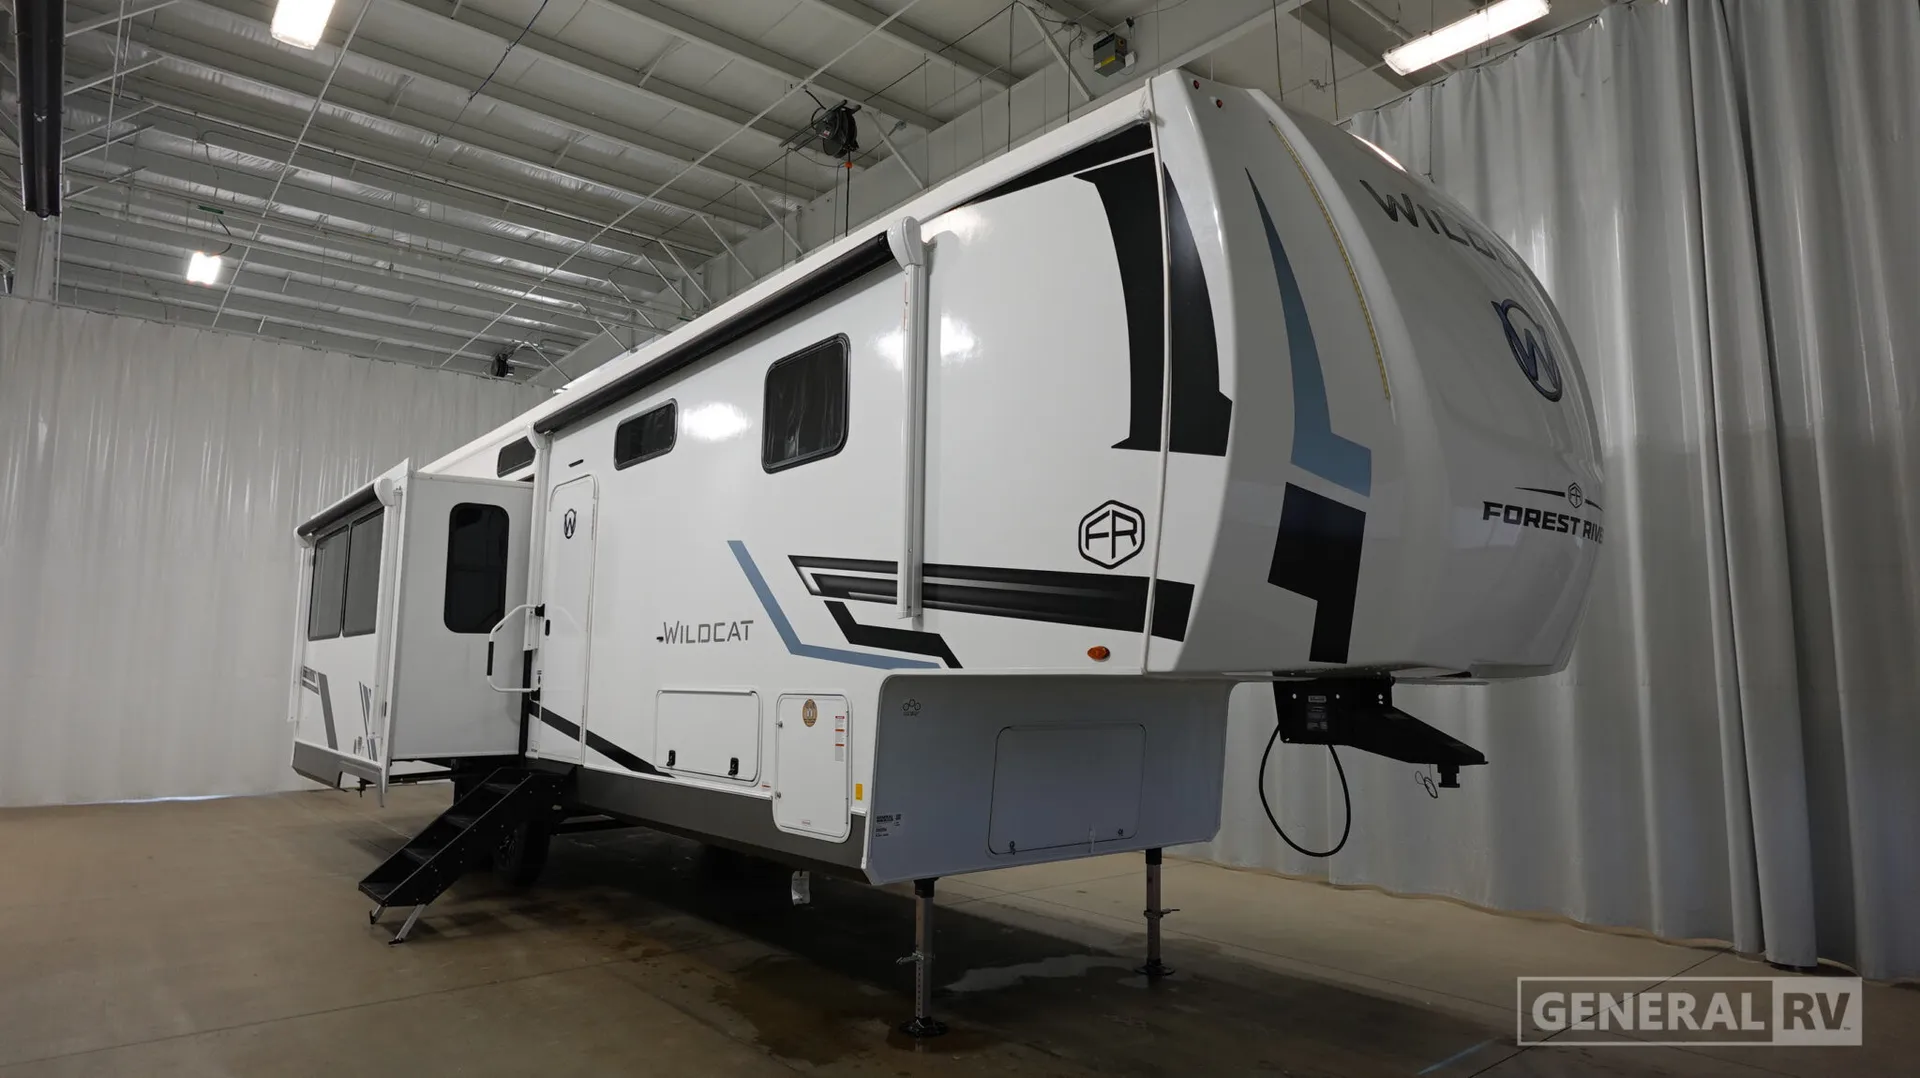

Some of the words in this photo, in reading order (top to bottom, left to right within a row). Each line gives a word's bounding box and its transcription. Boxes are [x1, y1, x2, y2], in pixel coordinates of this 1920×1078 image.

[1482, 501, 1581, 536] FOREST
[1582, 519, 1604, 544] RIVE
[663, 620, 754, 644] WILDCAT
